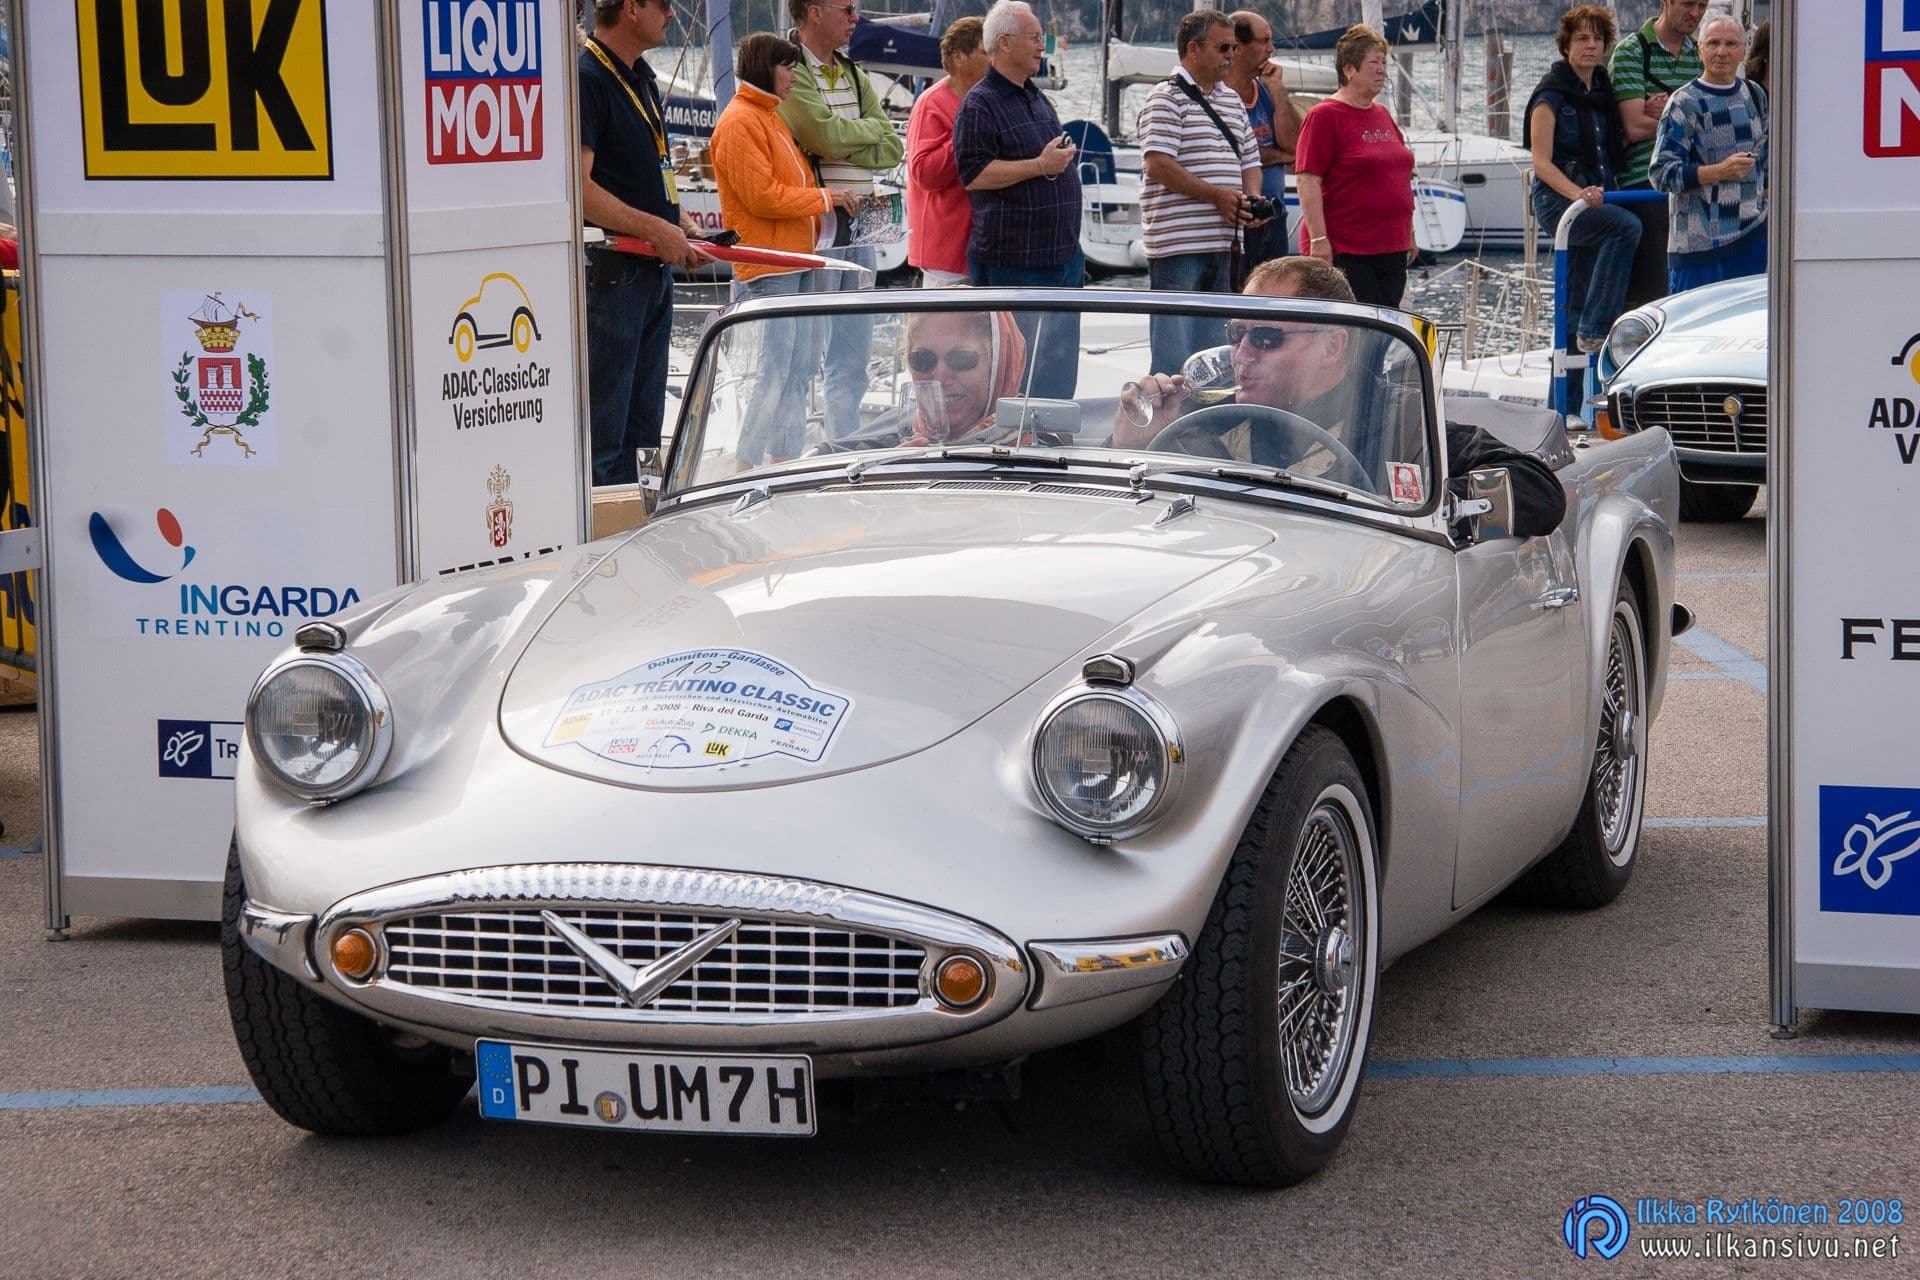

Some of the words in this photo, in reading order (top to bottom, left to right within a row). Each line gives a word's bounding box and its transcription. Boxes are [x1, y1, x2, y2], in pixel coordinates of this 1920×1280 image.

[428, 0, 537, 77] LIQUI
[431, 83, 541, 156] MOLY
[453, 397, 543, 431] Versicherung
[136, 617, 284, 638] TRENTINO
[631, 678, 738, 695] TRENTINO
[740, 684, 836, 717] CLASSIC
[653, 702, 681, 712] 2008
[691, 703, 714, 714] Riva
[717, 704, 736, 716] del
[737, 709, 770, 722] Garda
[718, 725, 759, 741] DEKRA
[770, 739, 811, 755] FERRARI
[493, 1087, 505, 1104] D
[514, 1055, 589, 1116] PI
